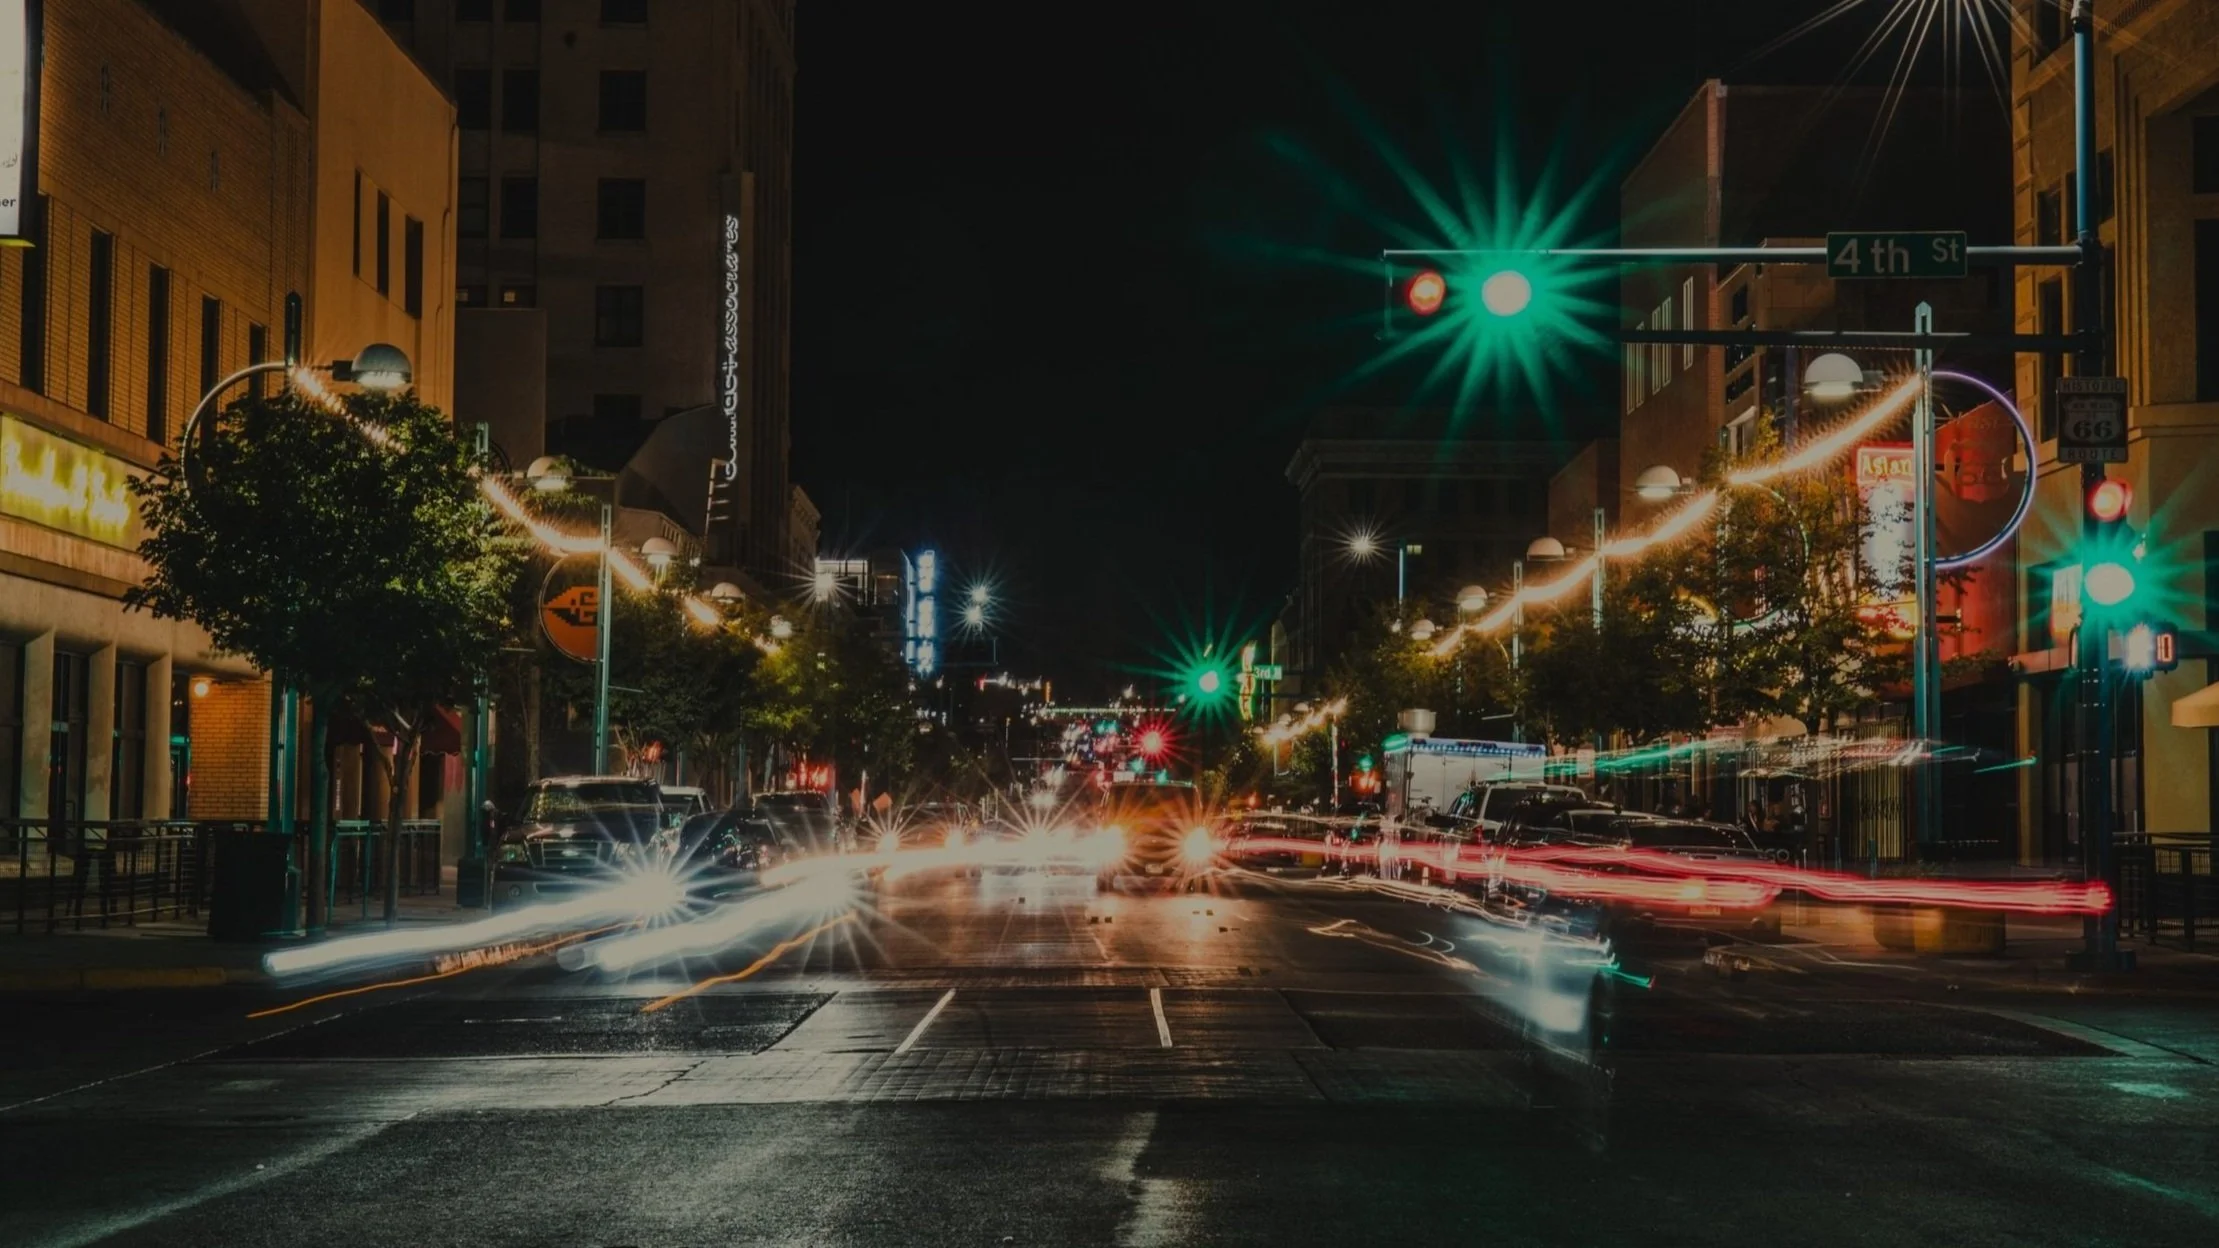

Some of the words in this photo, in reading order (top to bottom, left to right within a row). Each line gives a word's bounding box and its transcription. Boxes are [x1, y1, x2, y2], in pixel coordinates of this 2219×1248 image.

[1932, 237, 1959, 262] St
[2061, 380, 2122, 393] HISTORIC
[2072, 419, 2113, 439] 66
[2067, 449, 2118, 460] ROUTE
